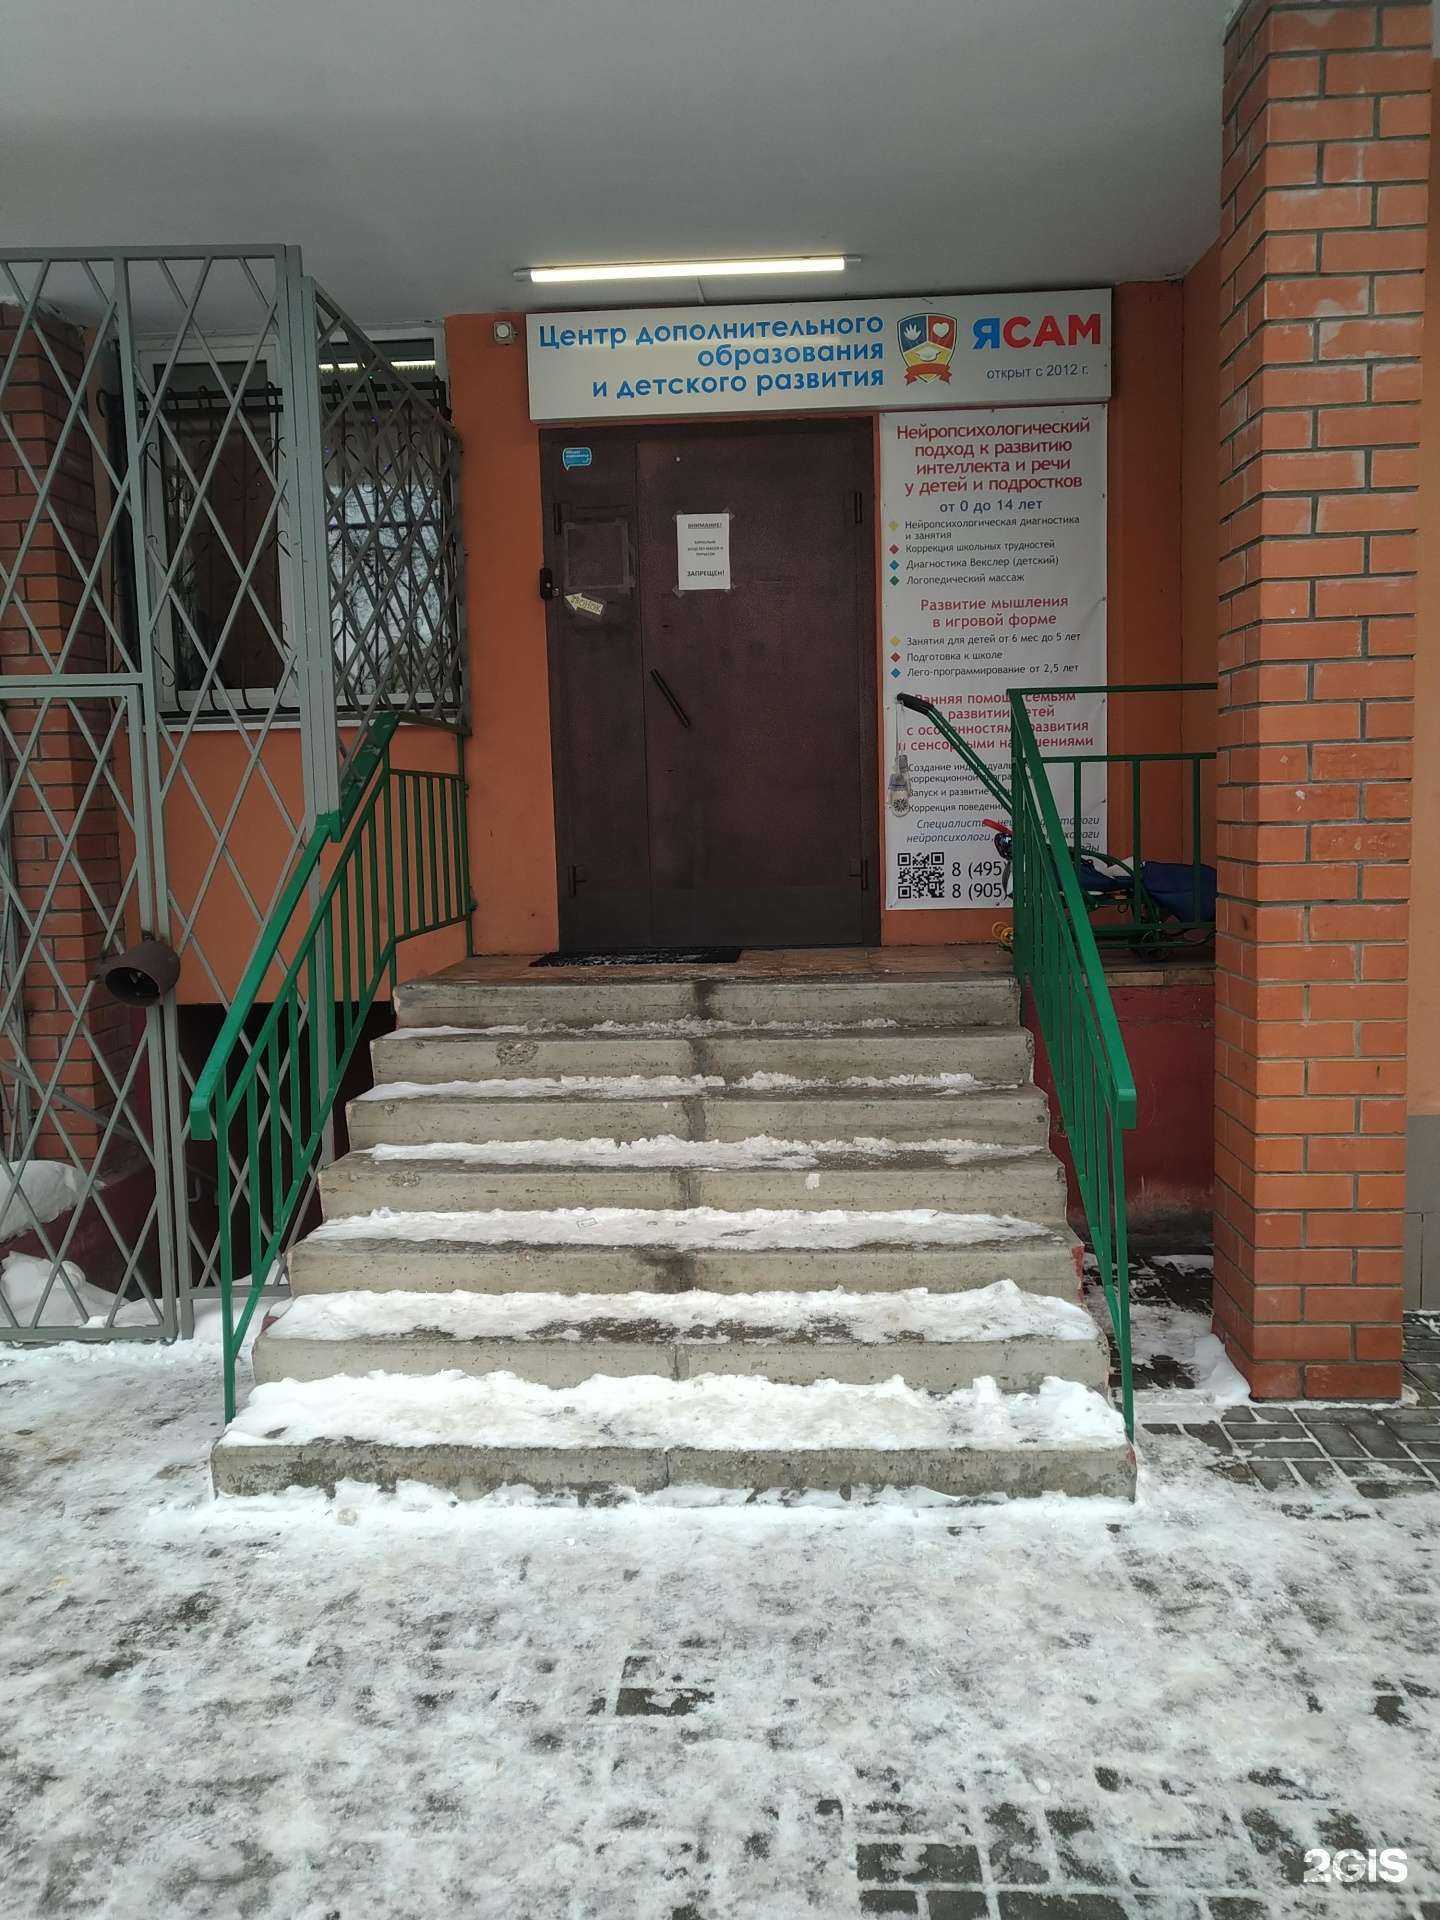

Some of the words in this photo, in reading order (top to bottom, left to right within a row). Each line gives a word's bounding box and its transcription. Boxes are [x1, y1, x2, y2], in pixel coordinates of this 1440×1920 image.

[538, 325, 628, 350] Центр
[635, 312, 884, 345] дополнительного
[697, 342, 884, 369] образования
[986, 366, 1031, 381] открыт
[1035, 367, 1042, 378] с
[1045, 364, 1077, 378] 2012
[1081, 365, 1090, 376] г.
[592, 380, 608, 397] и
[616, 371, 747, 399] детского
[756, 370, 884, 396] развития
[897, 417, 1090, 441] Нейропсихологический
[915, 443, 974, 459] подход
[980, 444, 989, 455] к
[994, 440, 1072, 457] развитию
[916, 460, 1010, 476] интеллекта
[1016, 460, 1026, 471] и
[1031, 459, 1071, 475] речи
[905, 482, 914, 496] у
[919, 476, 967, 496] детей
[973, 480, 983, 491] и
[989, 475, 1083, 493] подростков
[940, 503, 955, 513] от
[960, 500, 969, 512] 0
[973, 501, 991, 514] до
[997, 499, 1013, 511] 14
[1018, 499, 1043, 511] лет
[905, 518, 1017, 531] Нейропсихологическая
[1019, 515, 1080, 527] диагностика
[914, 531, 952, 541] занятия
[905, 544, 954, 554] Коррекция
[956, 542, 1001, 552] школьных
[1004, 540, 1055, 551] трудностей
[906, 559, 967, 570] Диагностика
[970, 557, 1010, 569] Векслер
[1012, 556, 1059, 568] (детский)
[906, 573, 985, 586] Логопедический
[988, 574, 1025, 583] массаж
[920, 598, 987, 611] Развитие
[991, 595, 1069, 610] мышления
[932, 618, 940, 628] в
[945, 613, 1004, 629] игровой
[1008, 612, 1057, 628] форме
[906, 637, 945, 646] Занятия
[947, 637, 965, 646] для
[967, 634, 996, 646] детей
[998, 635, 1009, 644] от
[1011, 634, 1018, 643] 6
[1020, 634, 1038, 643] мес
[1041, 634, 1053, 643] до
[1056, 632, 1062, 642] 5
[1065, 632, 1081, 641] лет
[906, 653, 961, 663] Подготовка
[964, 652, 970, 660] к
[972, 651, 1003, 660] школе
[906, 664, 1026, 678] Лего-программирование
[1029, 665, 1040, 673] от
[1043, 663, 1060, 674] 2,5
[1062, 664, 1079, 673] лет
[967, 694, 1012, 705] помощ
[1025, 693, 1076, 702] семьям
[948, 709, 1010, 721] развитии
[1026, 704, 1055, 717] етей
[906, 727, 913, 736] с
[910, 740, 995, 752] сенсорыми
[908, 763, 952, 772] Создание
[949, 787, 989, 797] развитие
[909, 803, 956, 812] Коррекция
[959, 802, 1005, 811] поведени
[951, 861, 962, 877] 8
[968, 860, 1009, 879] (495)
[951, 883, 962, 898] 8
[968, 882, 1009, 901] (905)
